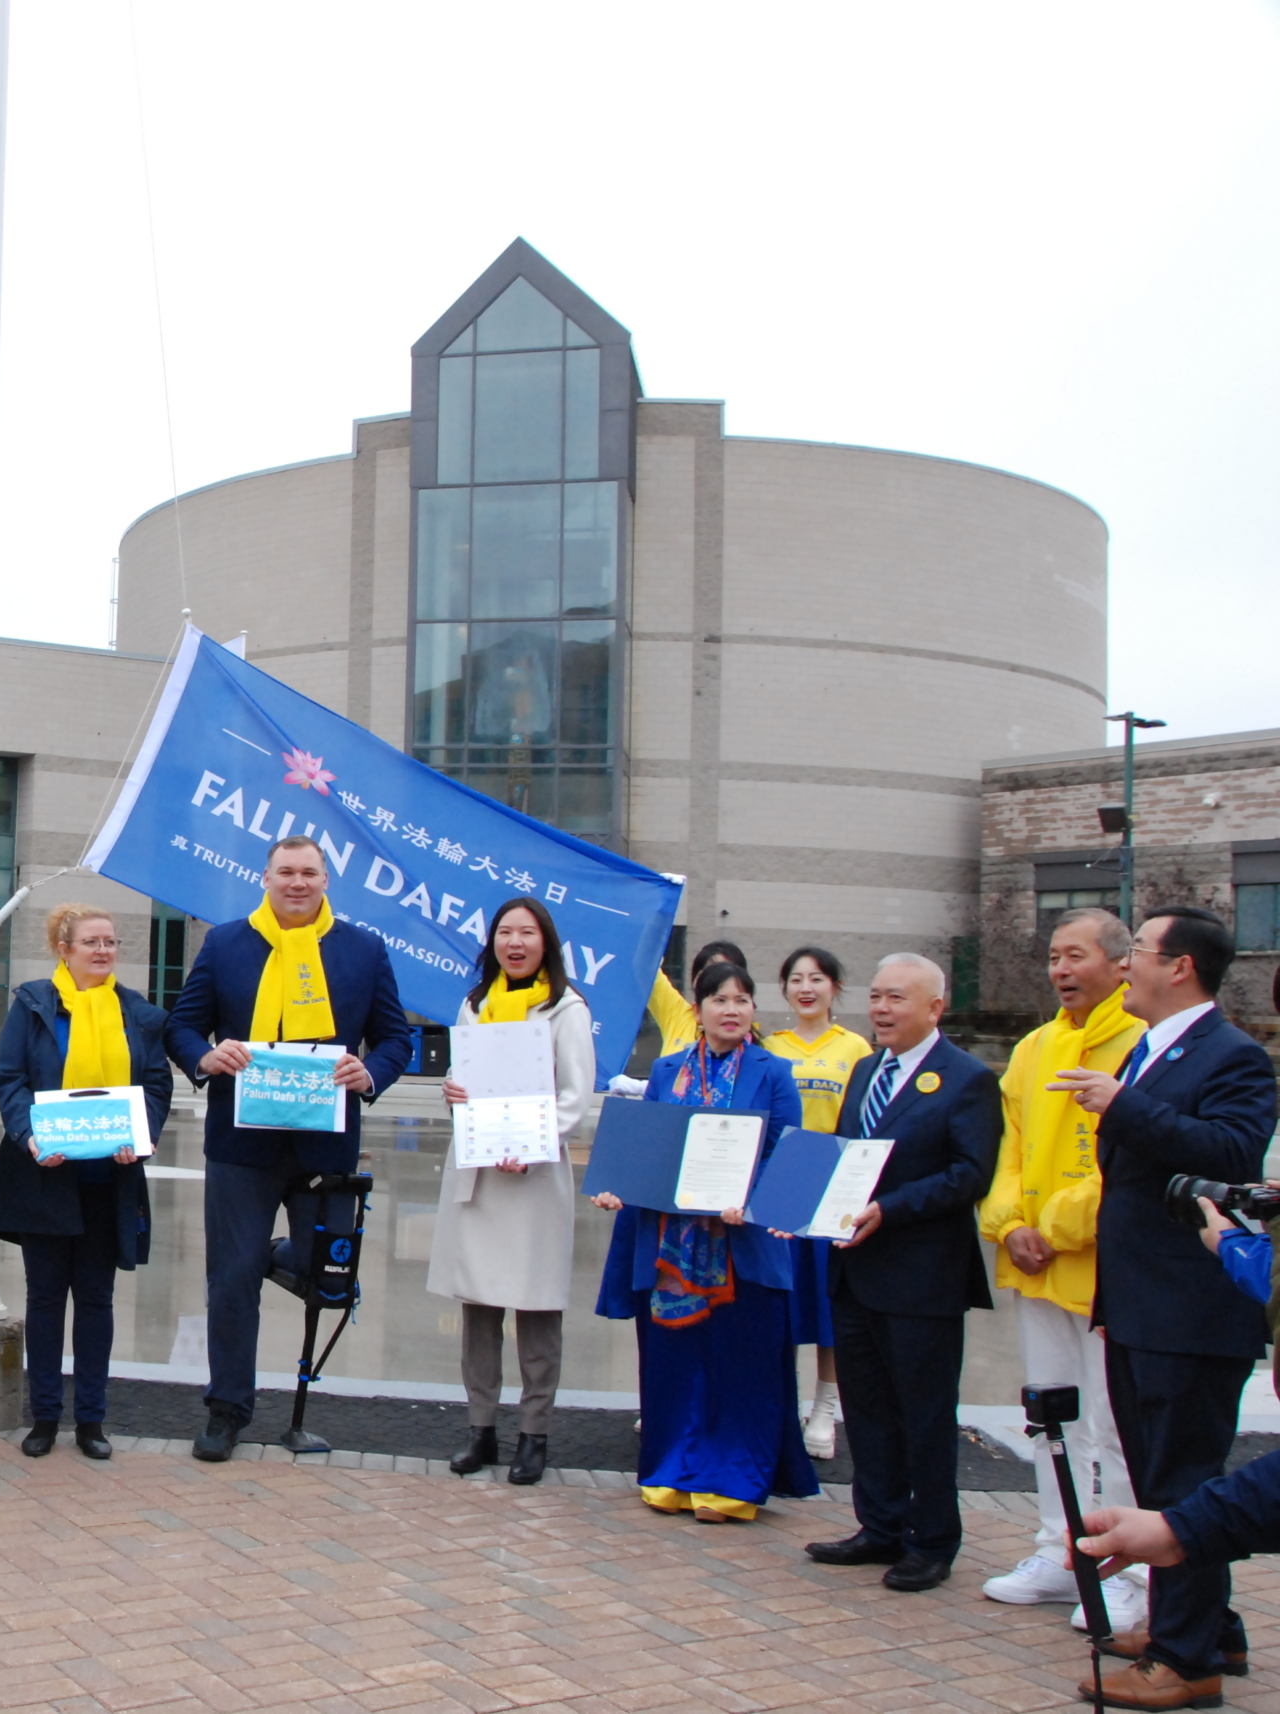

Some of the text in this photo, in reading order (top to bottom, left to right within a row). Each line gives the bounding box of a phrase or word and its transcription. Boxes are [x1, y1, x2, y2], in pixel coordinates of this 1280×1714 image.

[337, 790, 567, 904] 世界法輪大法日
[363, 855, 488, 947] DAFA
[243, 1066, 335, 1092] 法輪大法好
[243, 1087, 335, 1106] Falun Dafa is Good
[35, 1114, 131, 1133] 法輪大法好
[37, 1131, 130, 1142] Falun Dafa is Good
